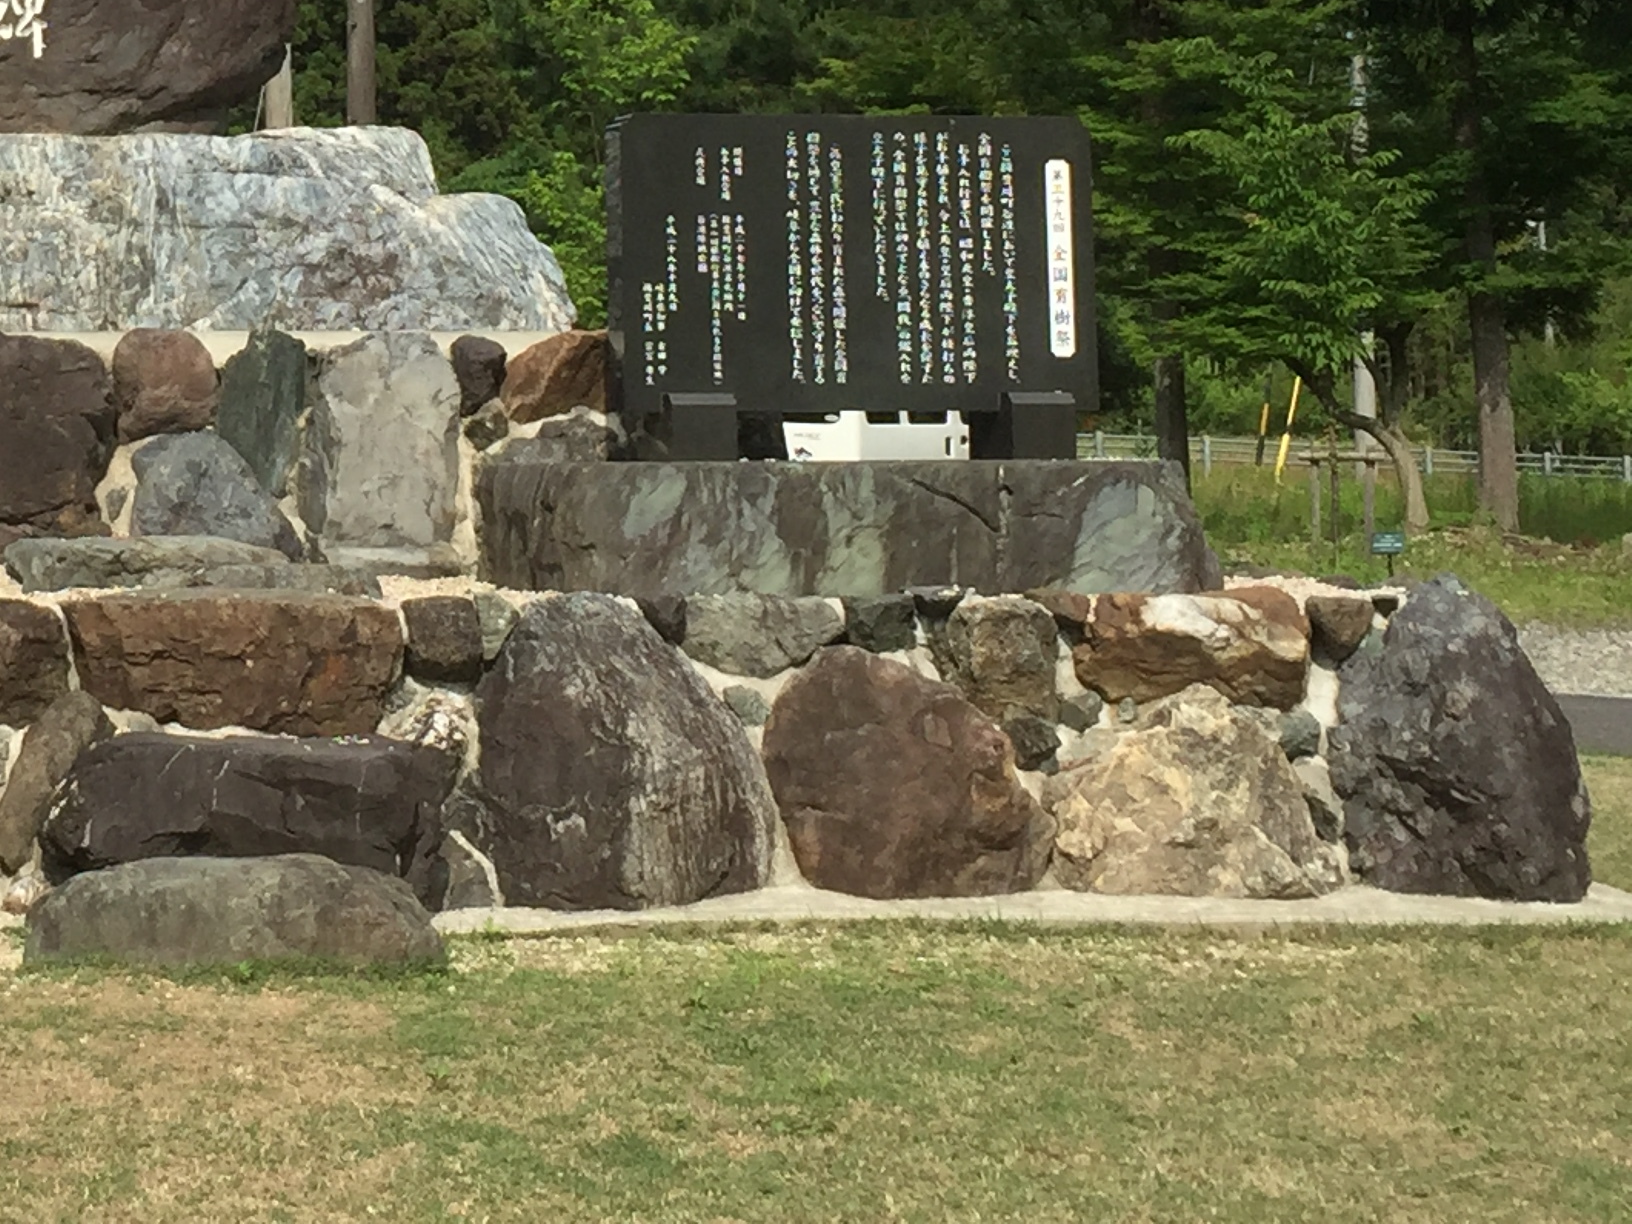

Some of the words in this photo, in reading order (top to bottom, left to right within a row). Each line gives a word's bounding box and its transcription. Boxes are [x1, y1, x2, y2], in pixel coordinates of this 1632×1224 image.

[1053, 245, 1071, 347] 全国育樹祭
